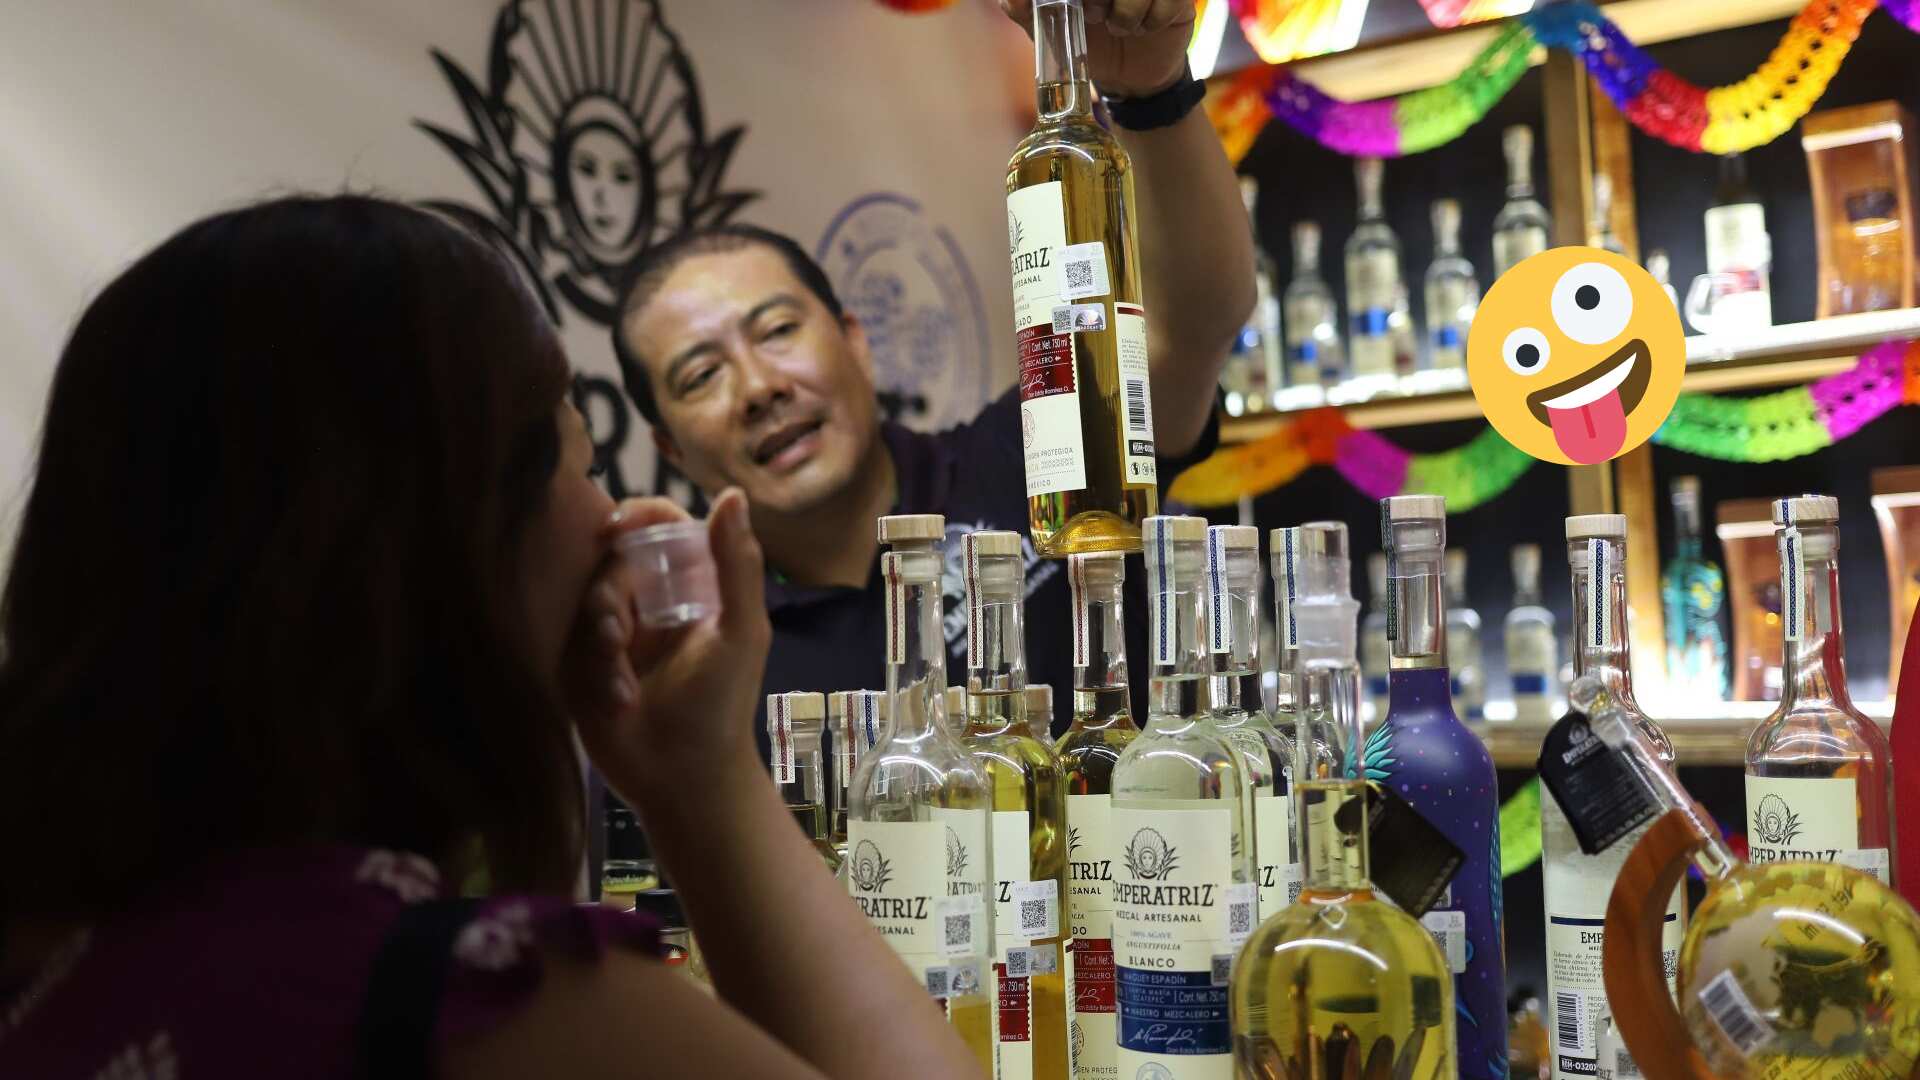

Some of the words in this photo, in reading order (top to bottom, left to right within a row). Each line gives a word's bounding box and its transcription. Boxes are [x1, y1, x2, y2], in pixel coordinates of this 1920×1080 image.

[1144, 912, 1202, 923] ARTESANAL
[1129, 955, 1176, 968] BLANCO
[1151, 974, 1187, 985] ESPADÍN
